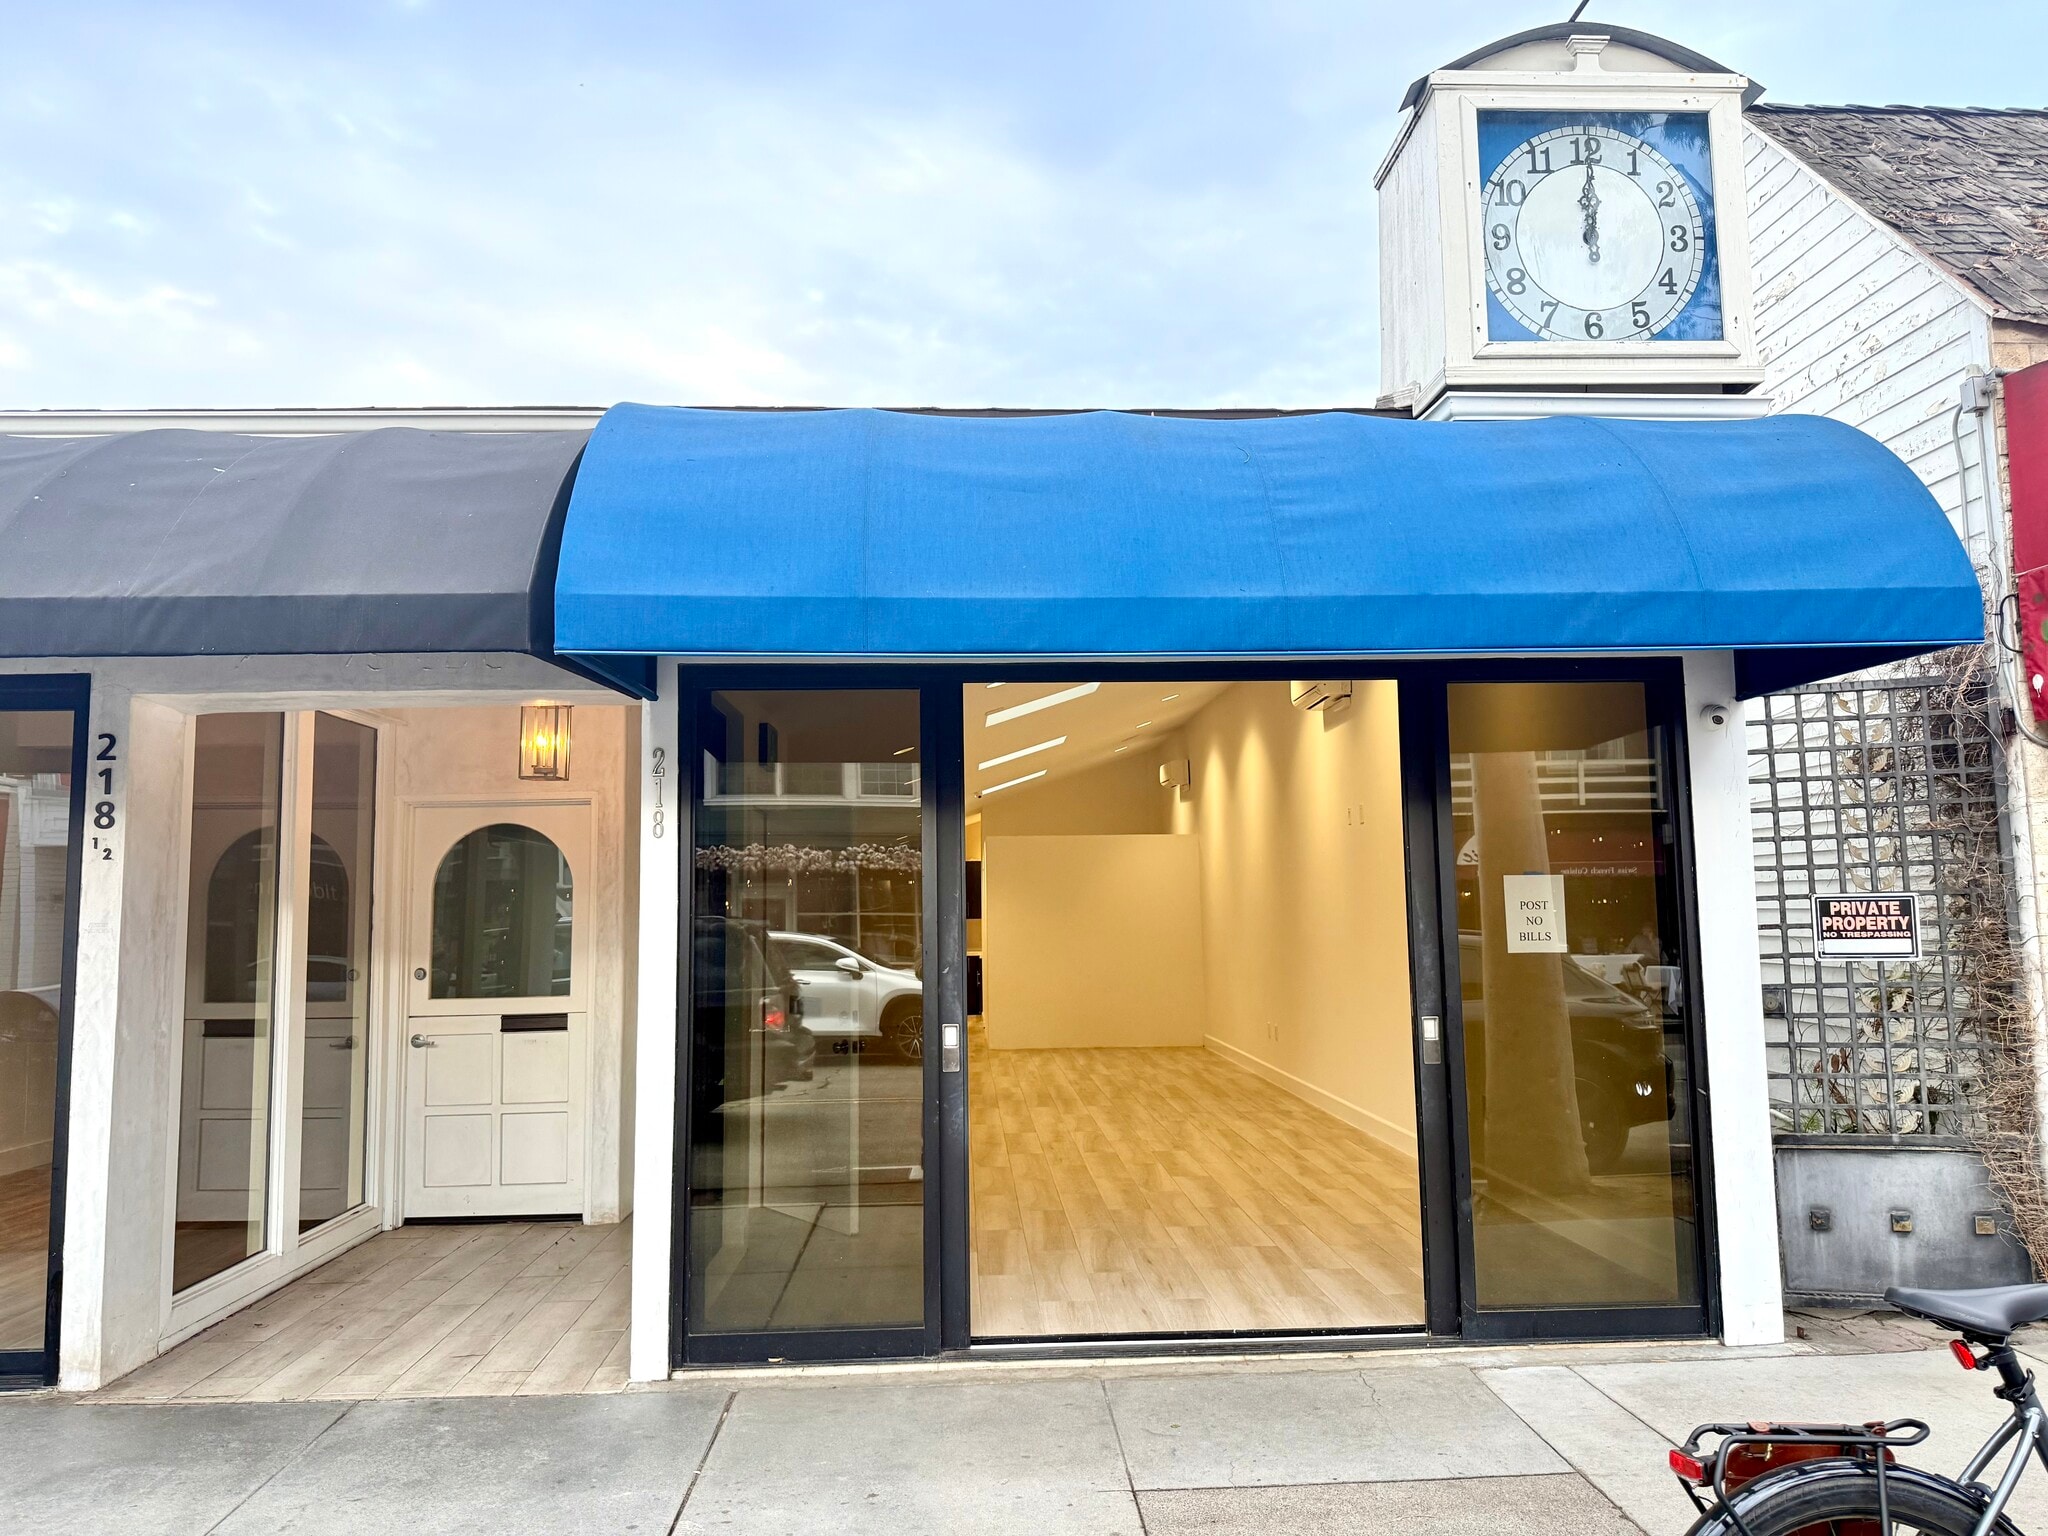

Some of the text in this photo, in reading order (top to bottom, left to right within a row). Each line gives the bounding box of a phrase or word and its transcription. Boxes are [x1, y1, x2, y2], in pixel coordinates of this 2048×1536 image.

[1526, 147, 1555, 174] 11
[1570, 137, 1603, 165] 12
[1627, 150, 1641, 176] 1
[1494, 179, 1527, 206] 10
[1656, 181, 1676, 208] 2
[1491, 223, 1511, 250] 9
[1670, 225, 1688, 252] 3
[1506, 268, 1526, 295] 8
[1658, 267, 1678, 295] 4
[1540, 300, 1559, 329] 7
[1584, 312, 1604, 339] 6
[1631, 301, 1650, 329] 5
[94, 733, 117, 830] 218
[652, 747, 665, 839] 218
[1520, 900, 1548, 910] POST
[1829, 901, 1901, 915] PRIVATE
[1526, 916, 1543, 925] NO
[1821, 916, 1910, 930] PROPERTY
[1519, 932, 1552, 941] BILLS
